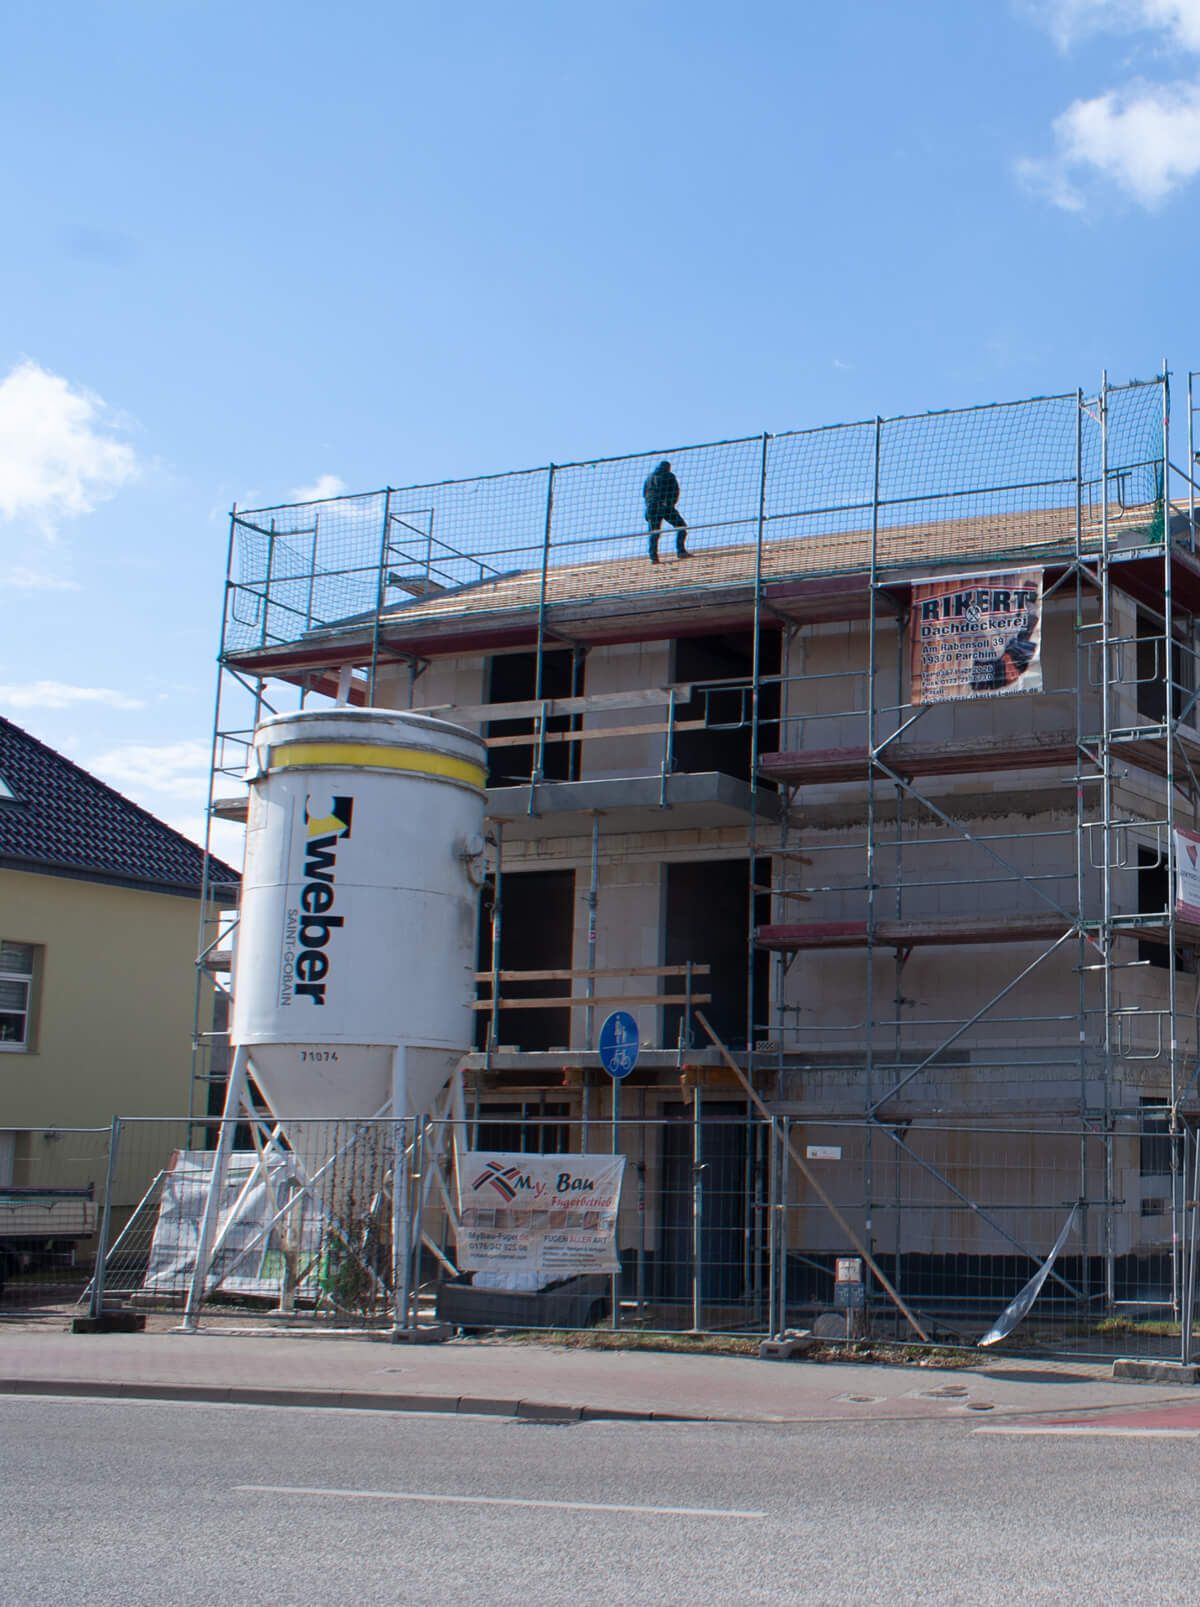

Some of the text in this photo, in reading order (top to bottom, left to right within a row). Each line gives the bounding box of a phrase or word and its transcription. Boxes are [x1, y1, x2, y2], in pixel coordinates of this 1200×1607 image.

[922, 590, 1029, 620] RIKERT
[921, 616, 1028, 637] Dachdeckerei
[923, 644, 938, 654] Am
[992, 637, 1004, 647] 39
[922, 651, 997, 665] 19370 Parchim
[293, 834, 344, 1006] weber
[280, 908, 299, 1006] SAINT-GOBAIN
[557, 1173, 594, 1192] Bau
